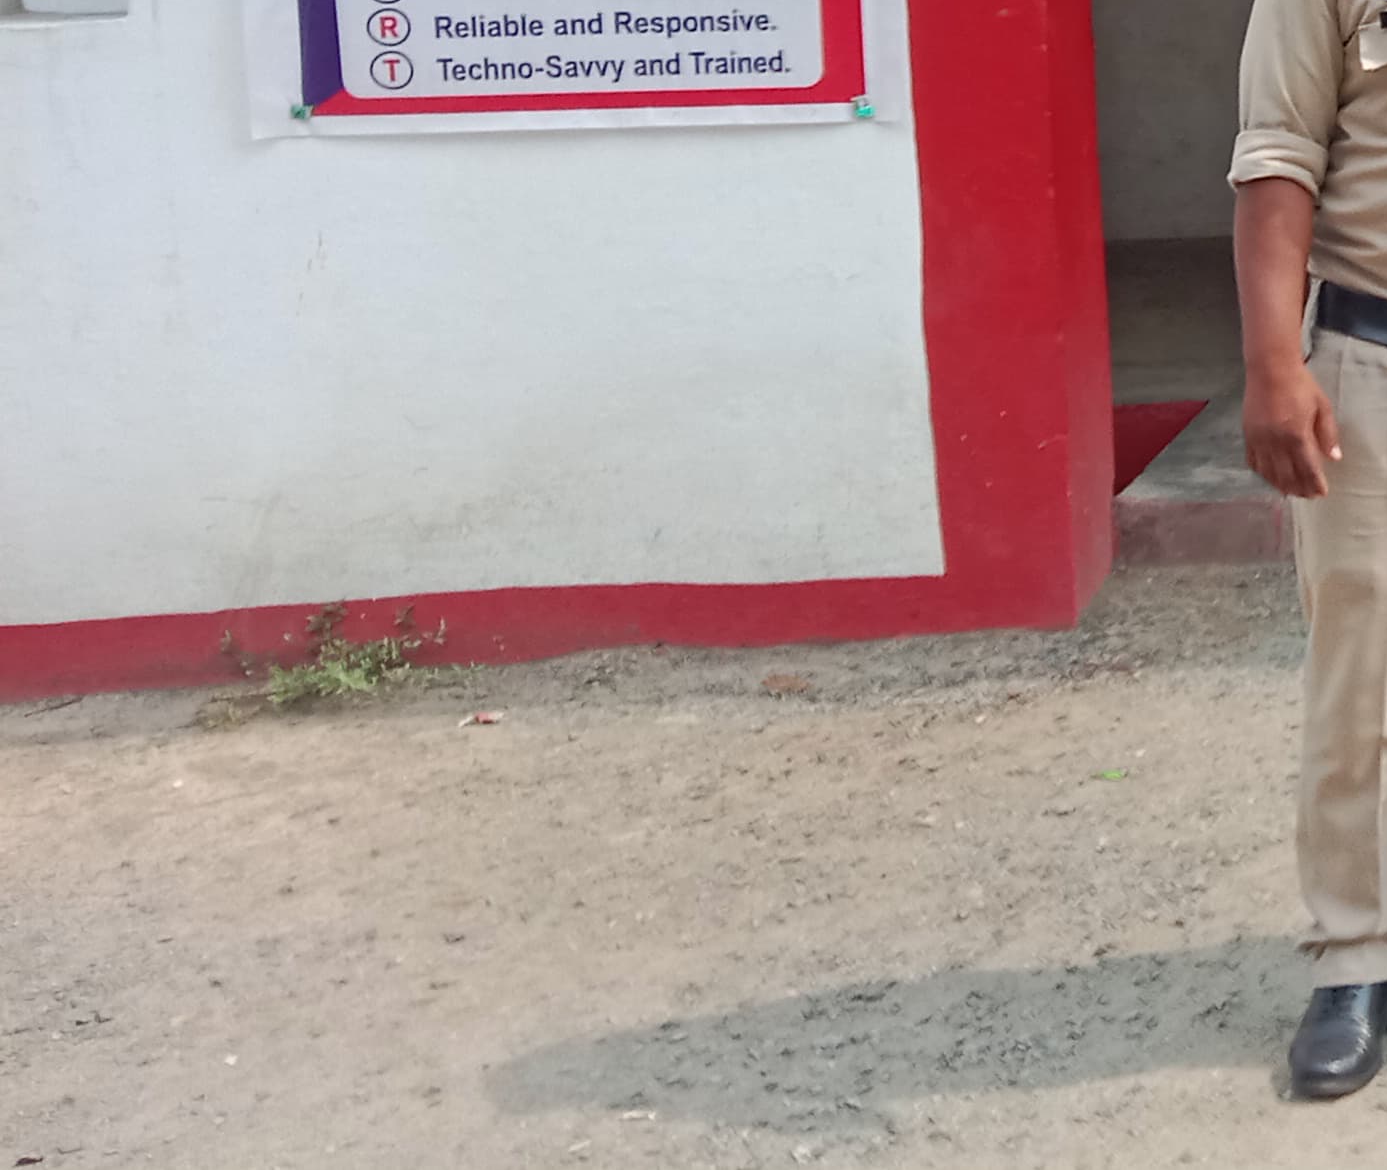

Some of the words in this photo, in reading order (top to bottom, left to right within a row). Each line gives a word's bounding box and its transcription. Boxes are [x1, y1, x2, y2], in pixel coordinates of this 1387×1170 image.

[379, 16, 399, 38] R
[434, 15, 543, 39] Reliable
[553, 13, 603, 35] and
[614, 9, 777, 38] Responsive.
[383, 59, 401, 82] T
[436, 55, 625, 83] Techno-Savvy
[634, 52, 681, 76] and
[688, 50, 791, 75] Trained.
